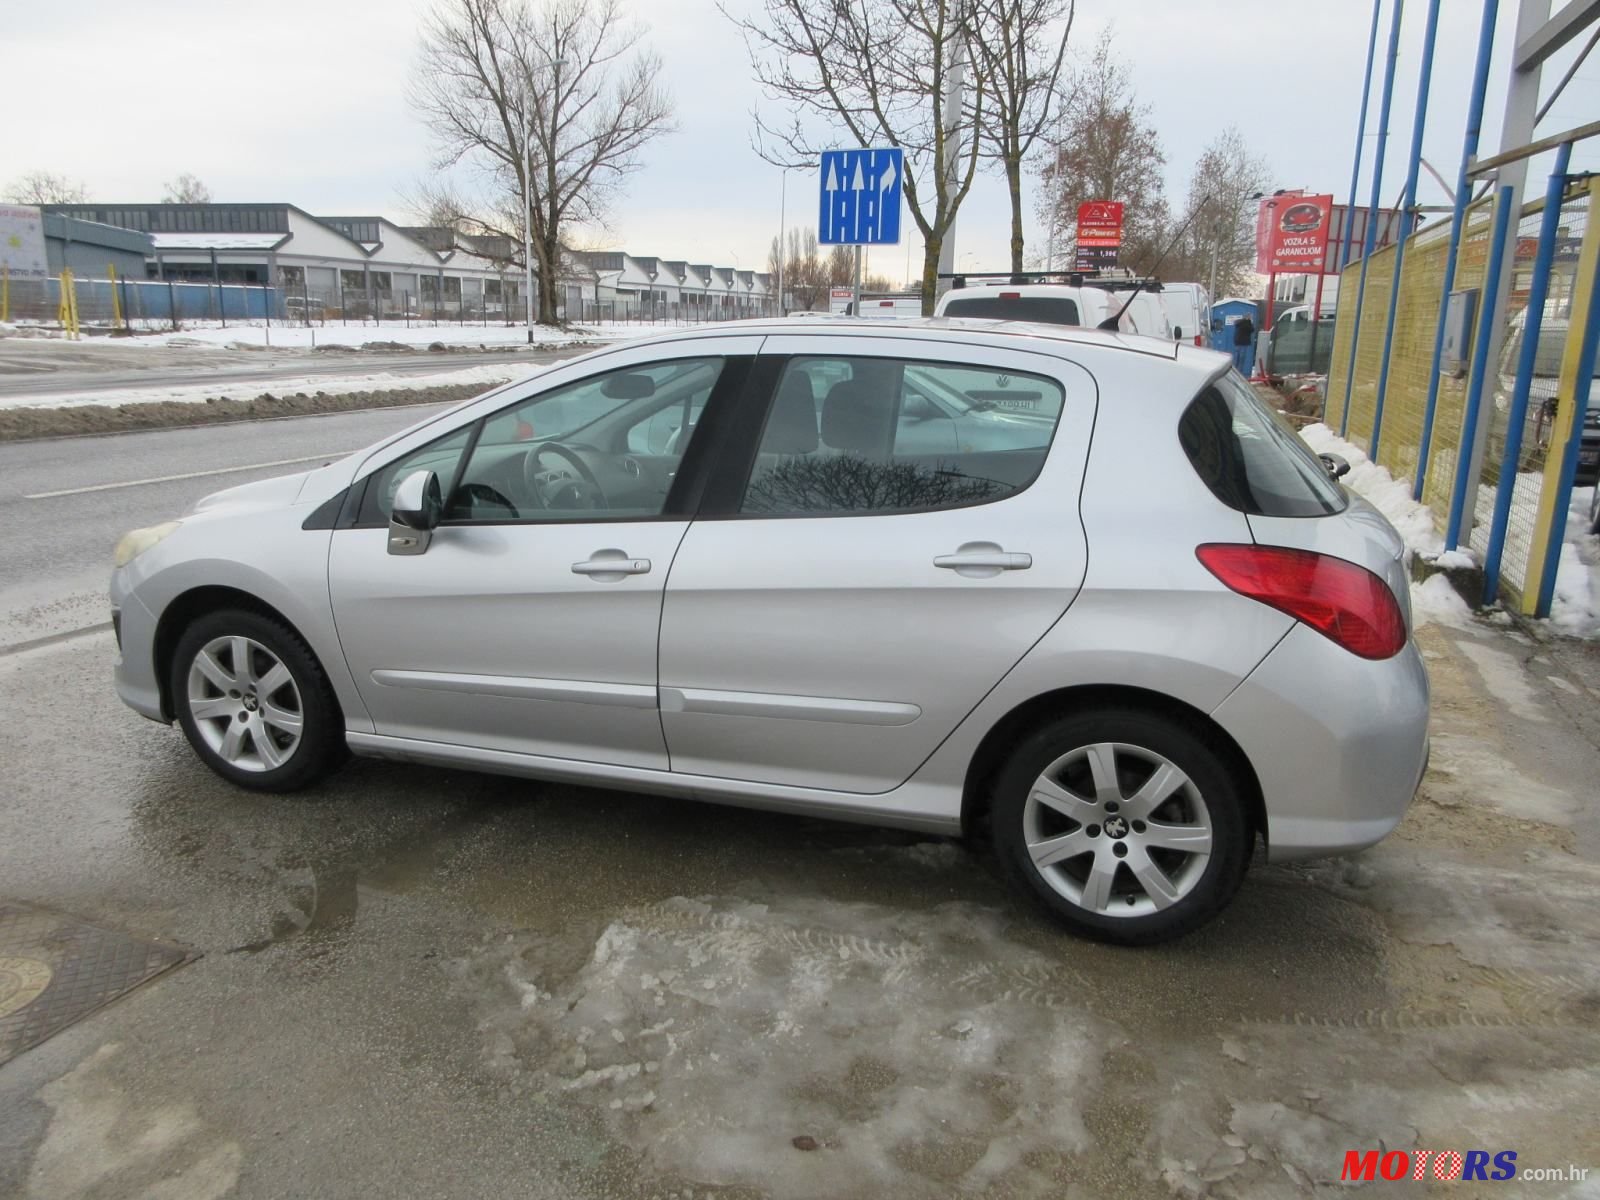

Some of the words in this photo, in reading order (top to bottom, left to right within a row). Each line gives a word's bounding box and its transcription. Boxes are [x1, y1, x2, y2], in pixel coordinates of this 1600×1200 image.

[1283, 237, 1308, 246] VOZILA
[1310, 236, 1316, 245] S
[1275, 246, 1321, 256] GARANCIJOM
